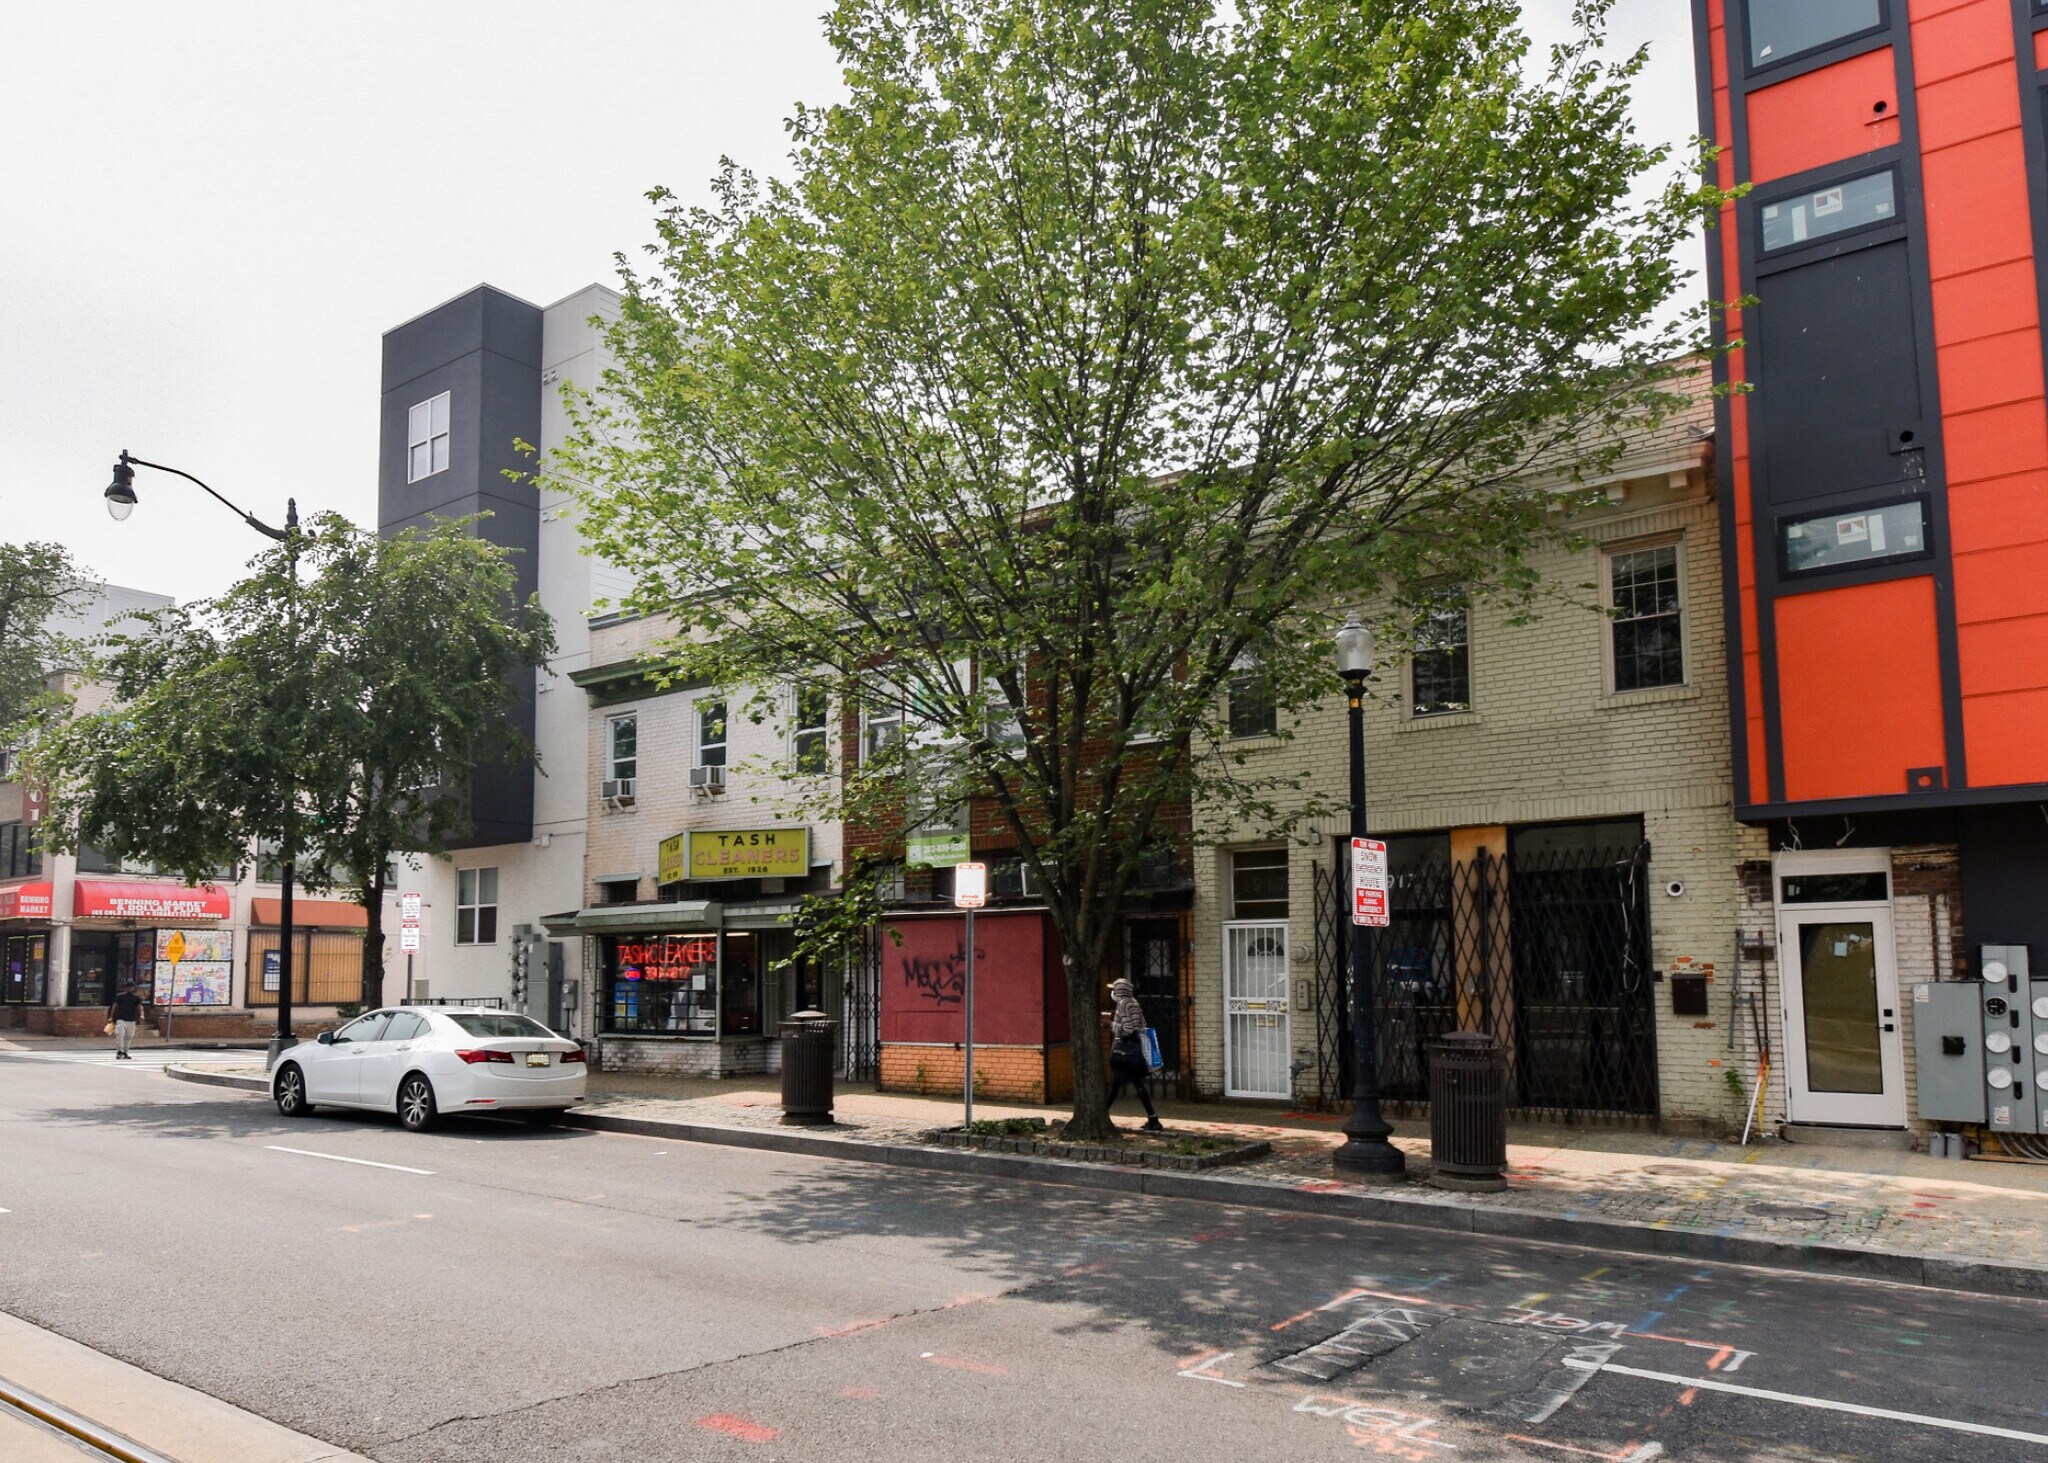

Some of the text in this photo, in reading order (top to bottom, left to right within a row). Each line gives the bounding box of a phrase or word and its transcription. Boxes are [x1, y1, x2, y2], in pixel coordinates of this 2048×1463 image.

[718, 834, 776, 847] TASH
[694, 848, 800, 866] CLEANERS
[1361, 851, 1377, 862] SNOW
[1356, 864, 1383, 873] EMERGENCY
[1359, 876, 1381, 888] ROUTE
[1365, 891, 1383, 899] PARKING
[110, 898, 207, 908] BENNING MARKET
[20, 905, 48, 914] MARKET
[128, 904, 171, 912] DOLLAR
[174, 905, 201, 913] PLUS
[617, 942, 717, 965] TASH CLEANERS
